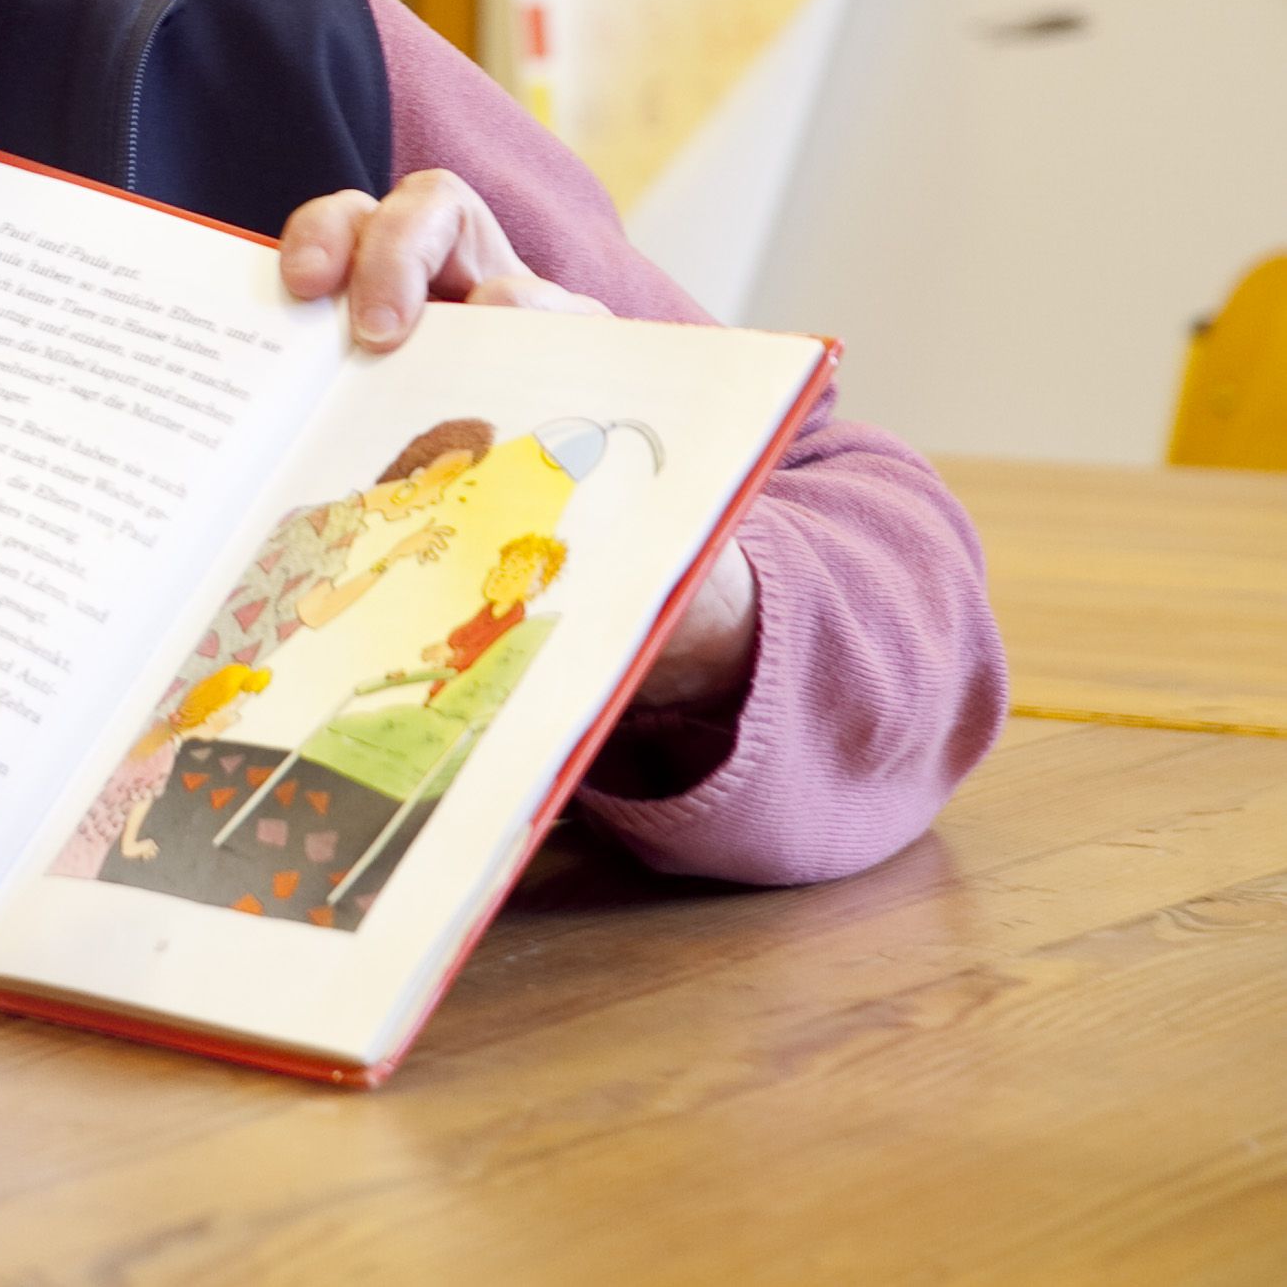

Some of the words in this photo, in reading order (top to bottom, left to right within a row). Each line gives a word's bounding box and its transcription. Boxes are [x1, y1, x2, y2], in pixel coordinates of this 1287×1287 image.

[33, 236, 70, 256] und
[65, 244, 113, 271] Paula
[11, 282, 58, 307] keine
[118, 316, 171, 343] Hause
[168, 332, 221, 361] halten.
[25, 258, 75, 286] haben
[222, 325, 260, 345] und
[258, 337, 284, 355] sie
[13, 338, 41, 356] die
[85, 359, 143, 388] kaputt
[139, 380, 176, 401] und
[170, 392, 235, 426] machen
[33, 319, 70, 337] und
[128, 349, 166, 368] und
[161, 360, 189, 377] sie
[187, 369, 251, 402] machen
[99, 392, 128, 412] die
[127, 400, 187, 434] Mutter
[185, 428, 223, 451] und
[8, 447, 49, 471] nach
[48, 462, 91, 486] einer
[92, 475, 145, 510] Woche
[69, 437, 120, 468] haben
[120, 461, 146, 479] sie
[146, 473, 188, 500] auch
[4, 473, 32, 493] die
[31, 482, 83, 514] Eltern
[112, 518, 159, 549] Paul
[24, 512, 80, 546] traurig.
[74, 599, 110, 625] und
